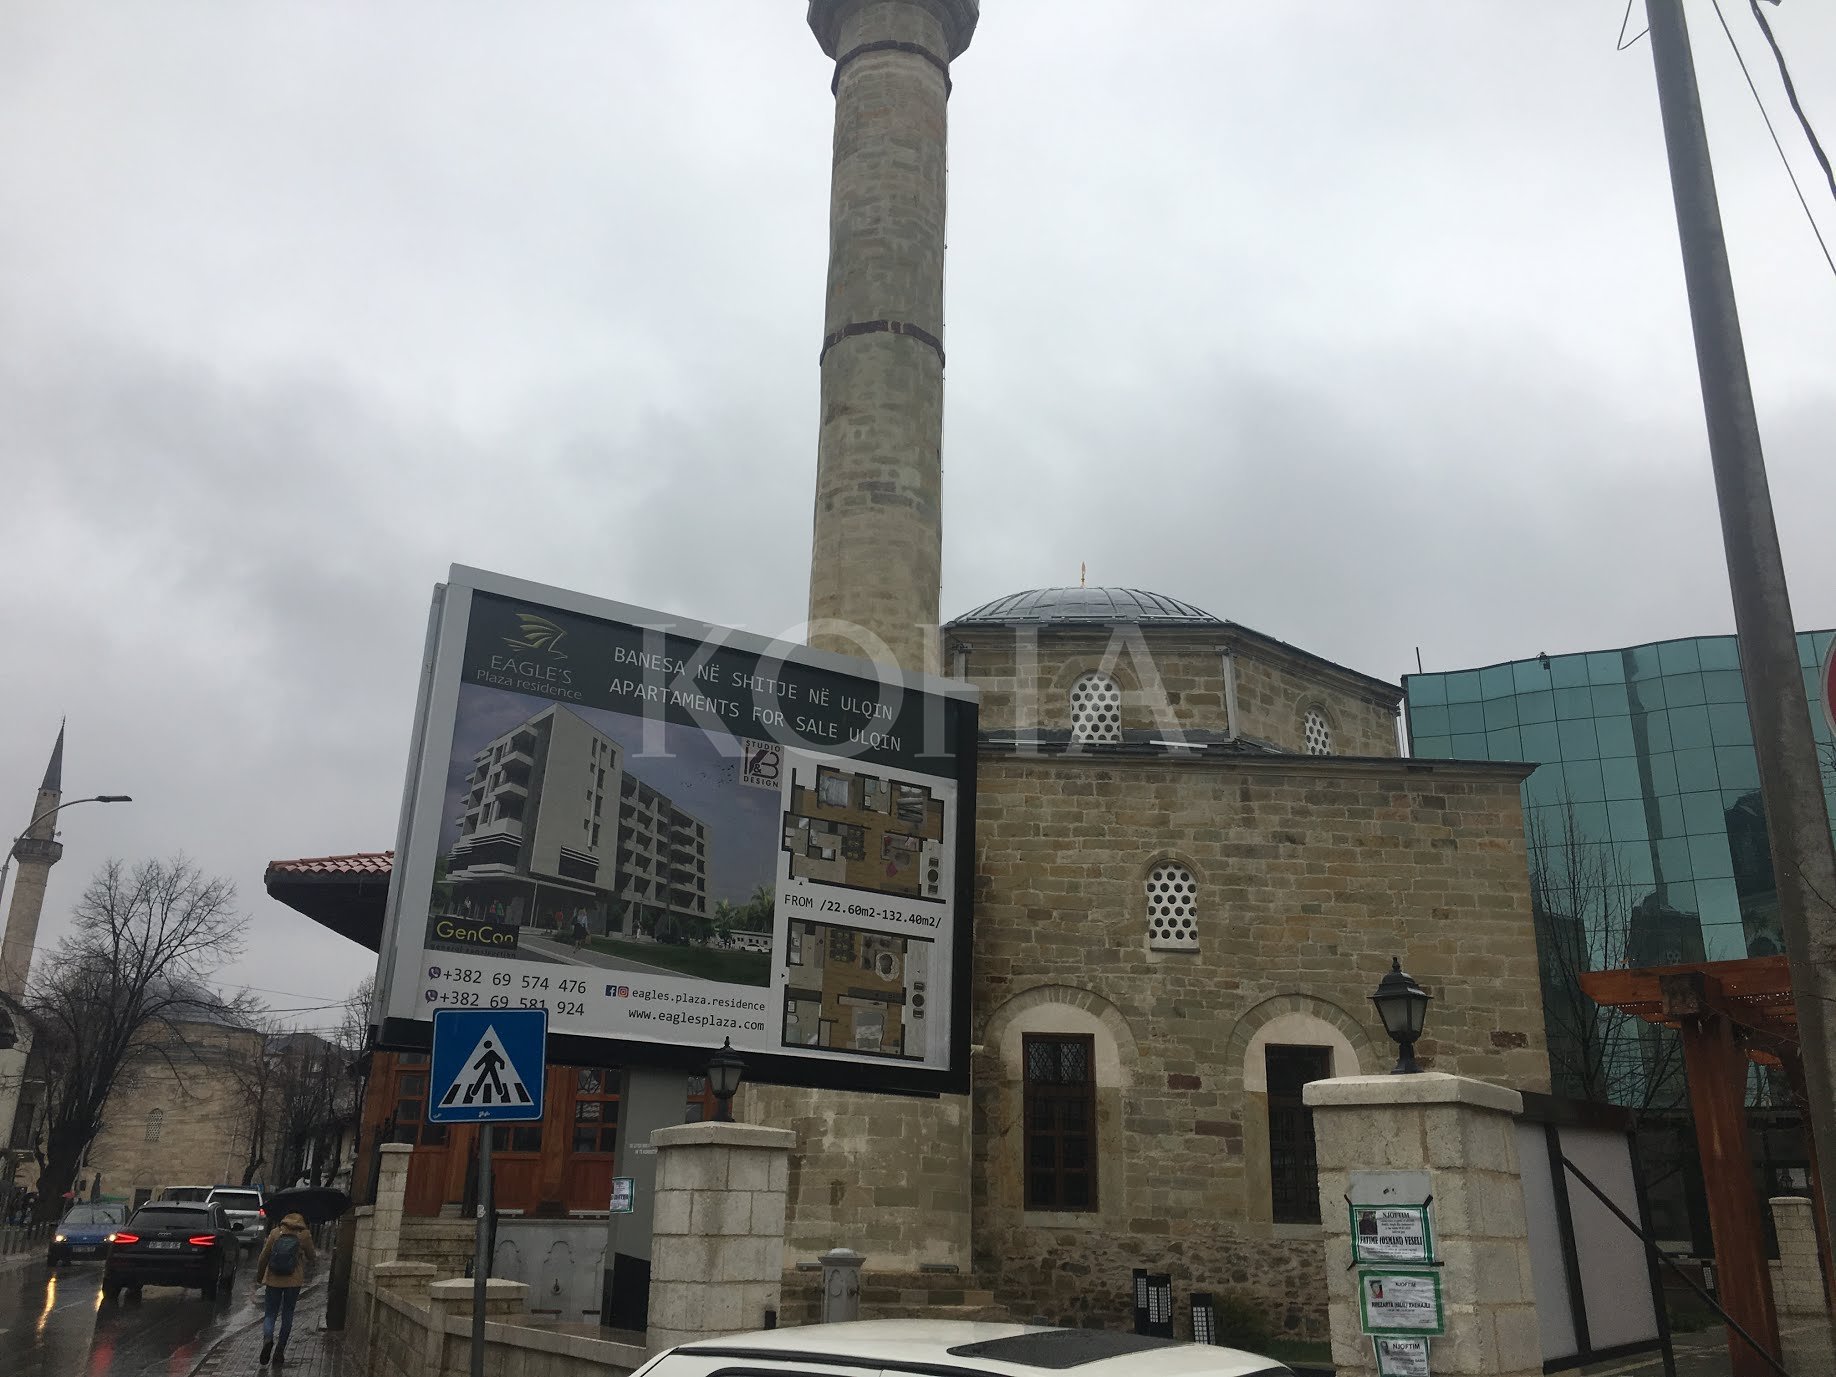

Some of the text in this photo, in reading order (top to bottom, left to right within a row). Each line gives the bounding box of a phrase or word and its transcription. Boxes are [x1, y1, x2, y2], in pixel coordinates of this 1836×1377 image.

[491, 655, 572, 684] EAGLE'S
[476, 669, 582, 700] Plaza residence
[614, 647, 893, 720] BANESA NË SHITJE NË ULQIN
[609, 678, 901, 751] APARTAMENTS FOR SALE ULQIN
[746, 740, 780, 752] STUDIO
[743, 776, 779, 788] DESIGN
[784, 894, 942, 929] FROM /22.60m2-132.40m2/
[436, 921, 514, 944] GenCon
[443, 968, 587, 994] +382 69 574 476
[440, 991, 479, 1006] +382
[489, 995, 509, 1008] 69
[556, 1001, 585, 1016] 924
[632, 988, 765, 1011] eagles.plaza.residence
[628, 1009, 765, 1031] www.eaglesplaza.com
